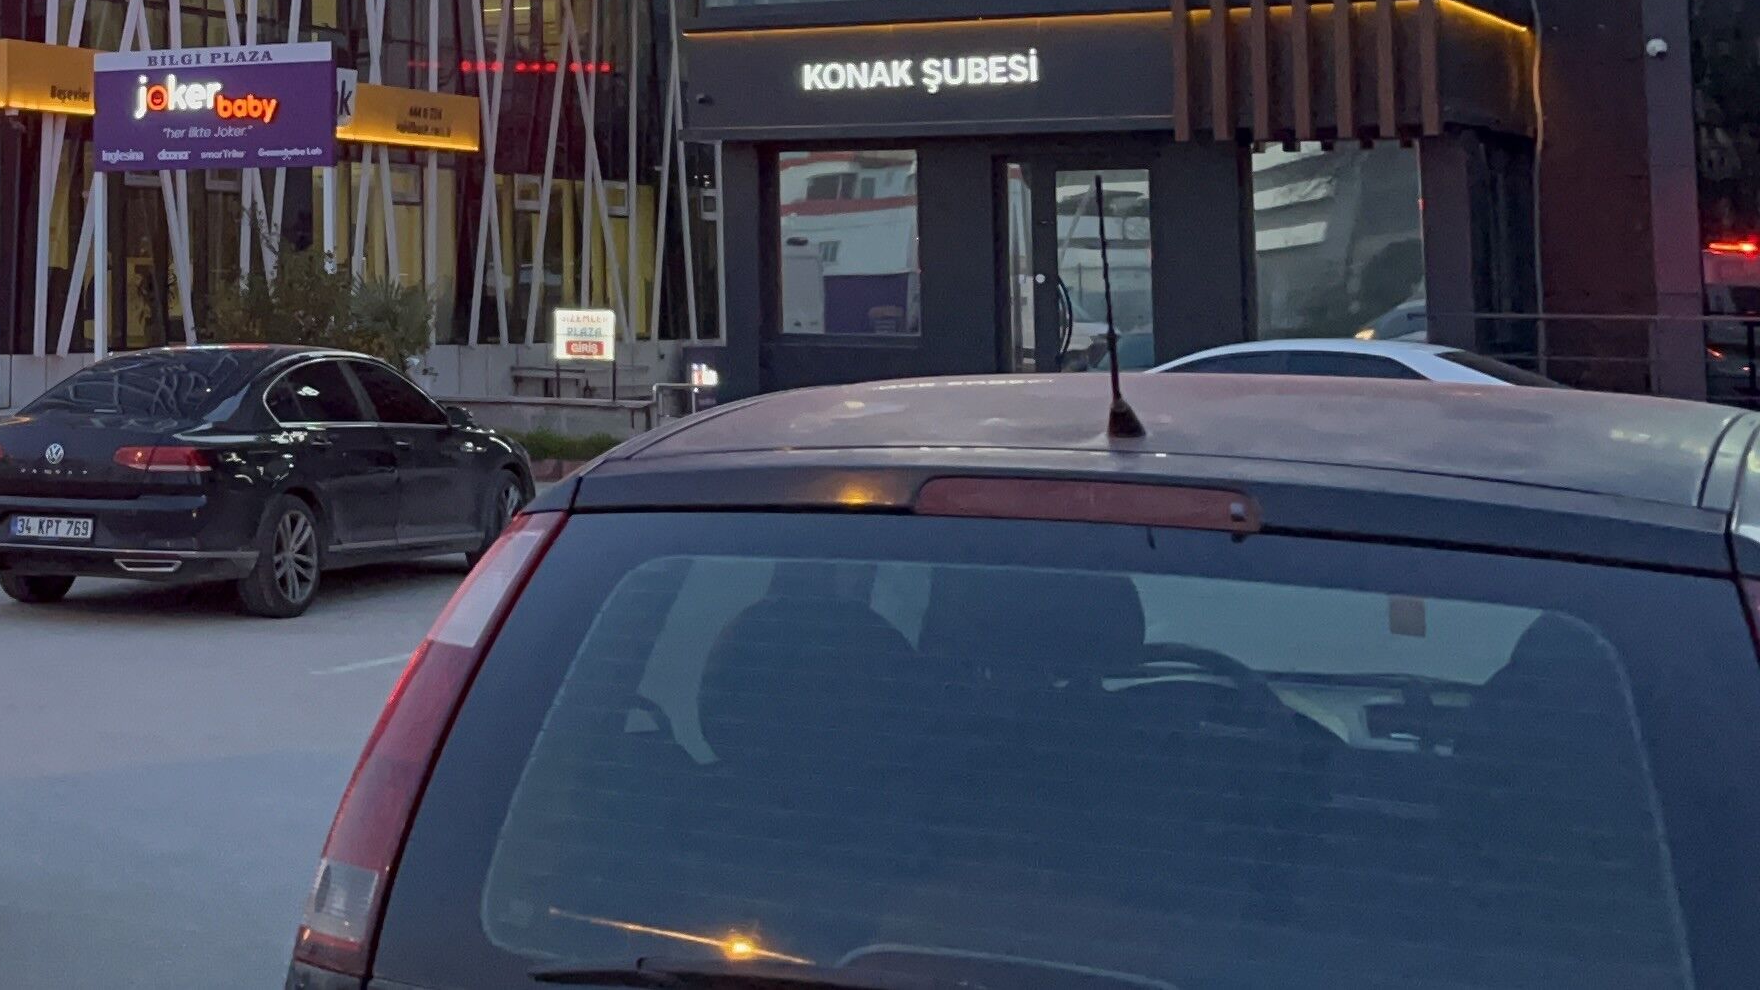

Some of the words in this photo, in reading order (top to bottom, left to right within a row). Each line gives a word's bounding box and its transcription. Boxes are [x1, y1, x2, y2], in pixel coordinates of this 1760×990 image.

[210, 49, 274, 65] PLAZA
[803, 58, 914, 91] KONAK
[921, 47, 1039, 94] ŞUBESİ
[133, 74, 222, 121] joker
[216, 93, 278, 124] baby
[566, 326, 603, 338] PLAZA
[17, 517, 32, 535] 34
[37, 518, 62, 536] KPT
[66, 520, 90, 537] 769
